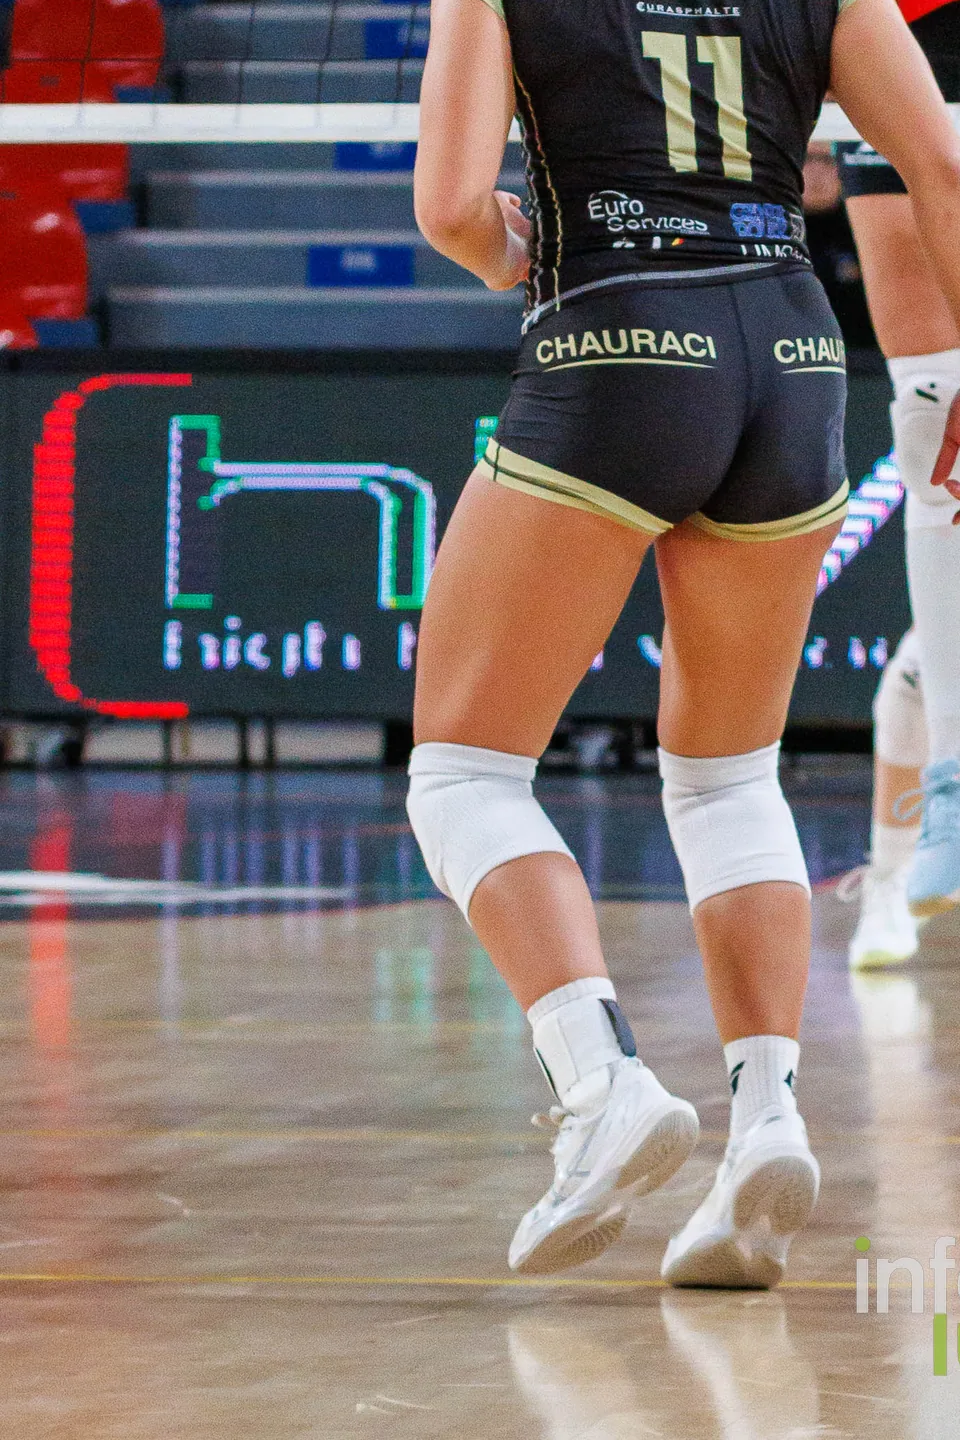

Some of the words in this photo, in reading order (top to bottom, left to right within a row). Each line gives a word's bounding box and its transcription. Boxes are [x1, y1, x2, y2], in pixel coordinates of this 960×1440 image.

[641, 31, 752, 182] 11
[588, 198, 644, 220] Euro
[607, 216, 709, 232] Services
[537, 328, 717, 364] CHAURACI
